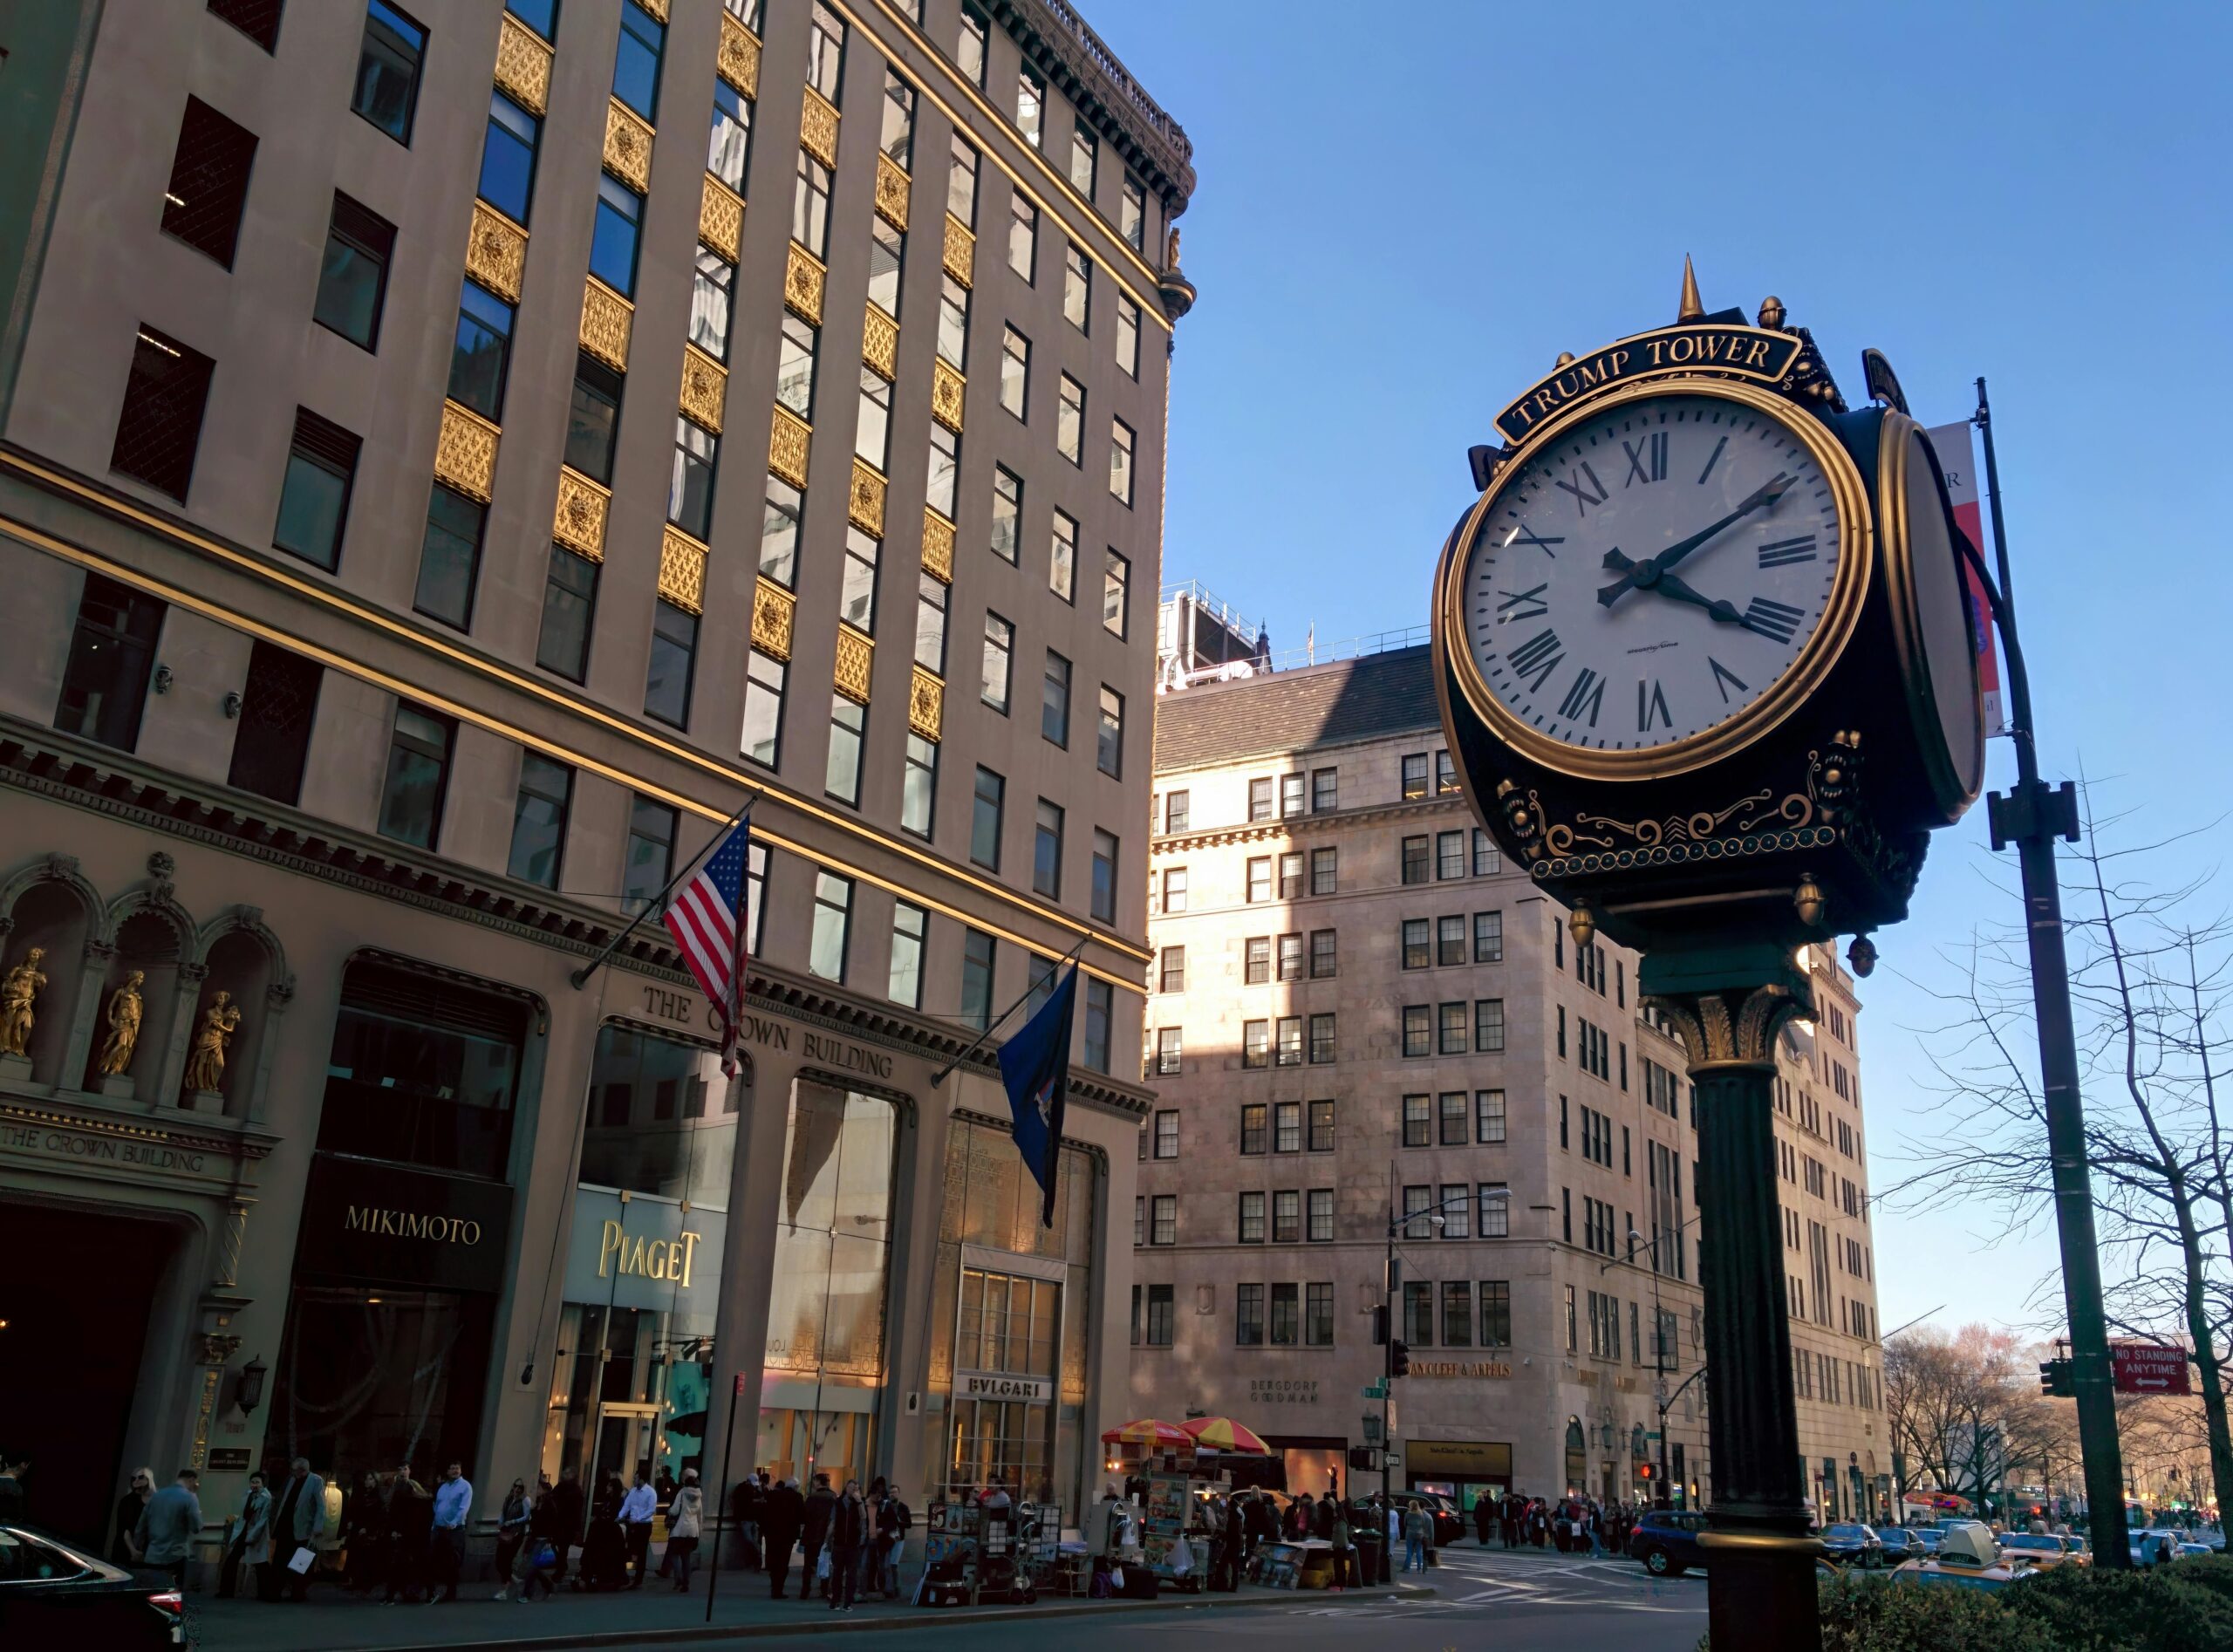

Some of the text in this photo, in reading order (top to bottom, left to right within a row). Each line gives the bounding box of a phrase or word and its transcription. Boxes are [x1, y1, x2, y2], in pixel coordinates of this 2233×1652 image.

[1512, 335, 1771, 427] TRUMP TOWER
[644, 986, 893, 1079] THE COWN BUILDING
[1, 1126, 204, 1172] THE CROWN BUILDING
[345, 1205, 481, 1246] MIKIMOTO
[2116, 1349, 2182, 1362] NO STANDING
[1427, 1362, 1458, 1376] CLEEF
[1461, 1363, 1467, 1376] &
[1472, 1362, 1512, 1377] ARPELS
[2127, 1364, 2176, 1376] ANYTIME
[968, 1377, 1041, 1397] BVLGARI
[1251, 1380, 1318, 1391] BERGDORF
[1251, 1392, 1318, 1403] GOODMAN
